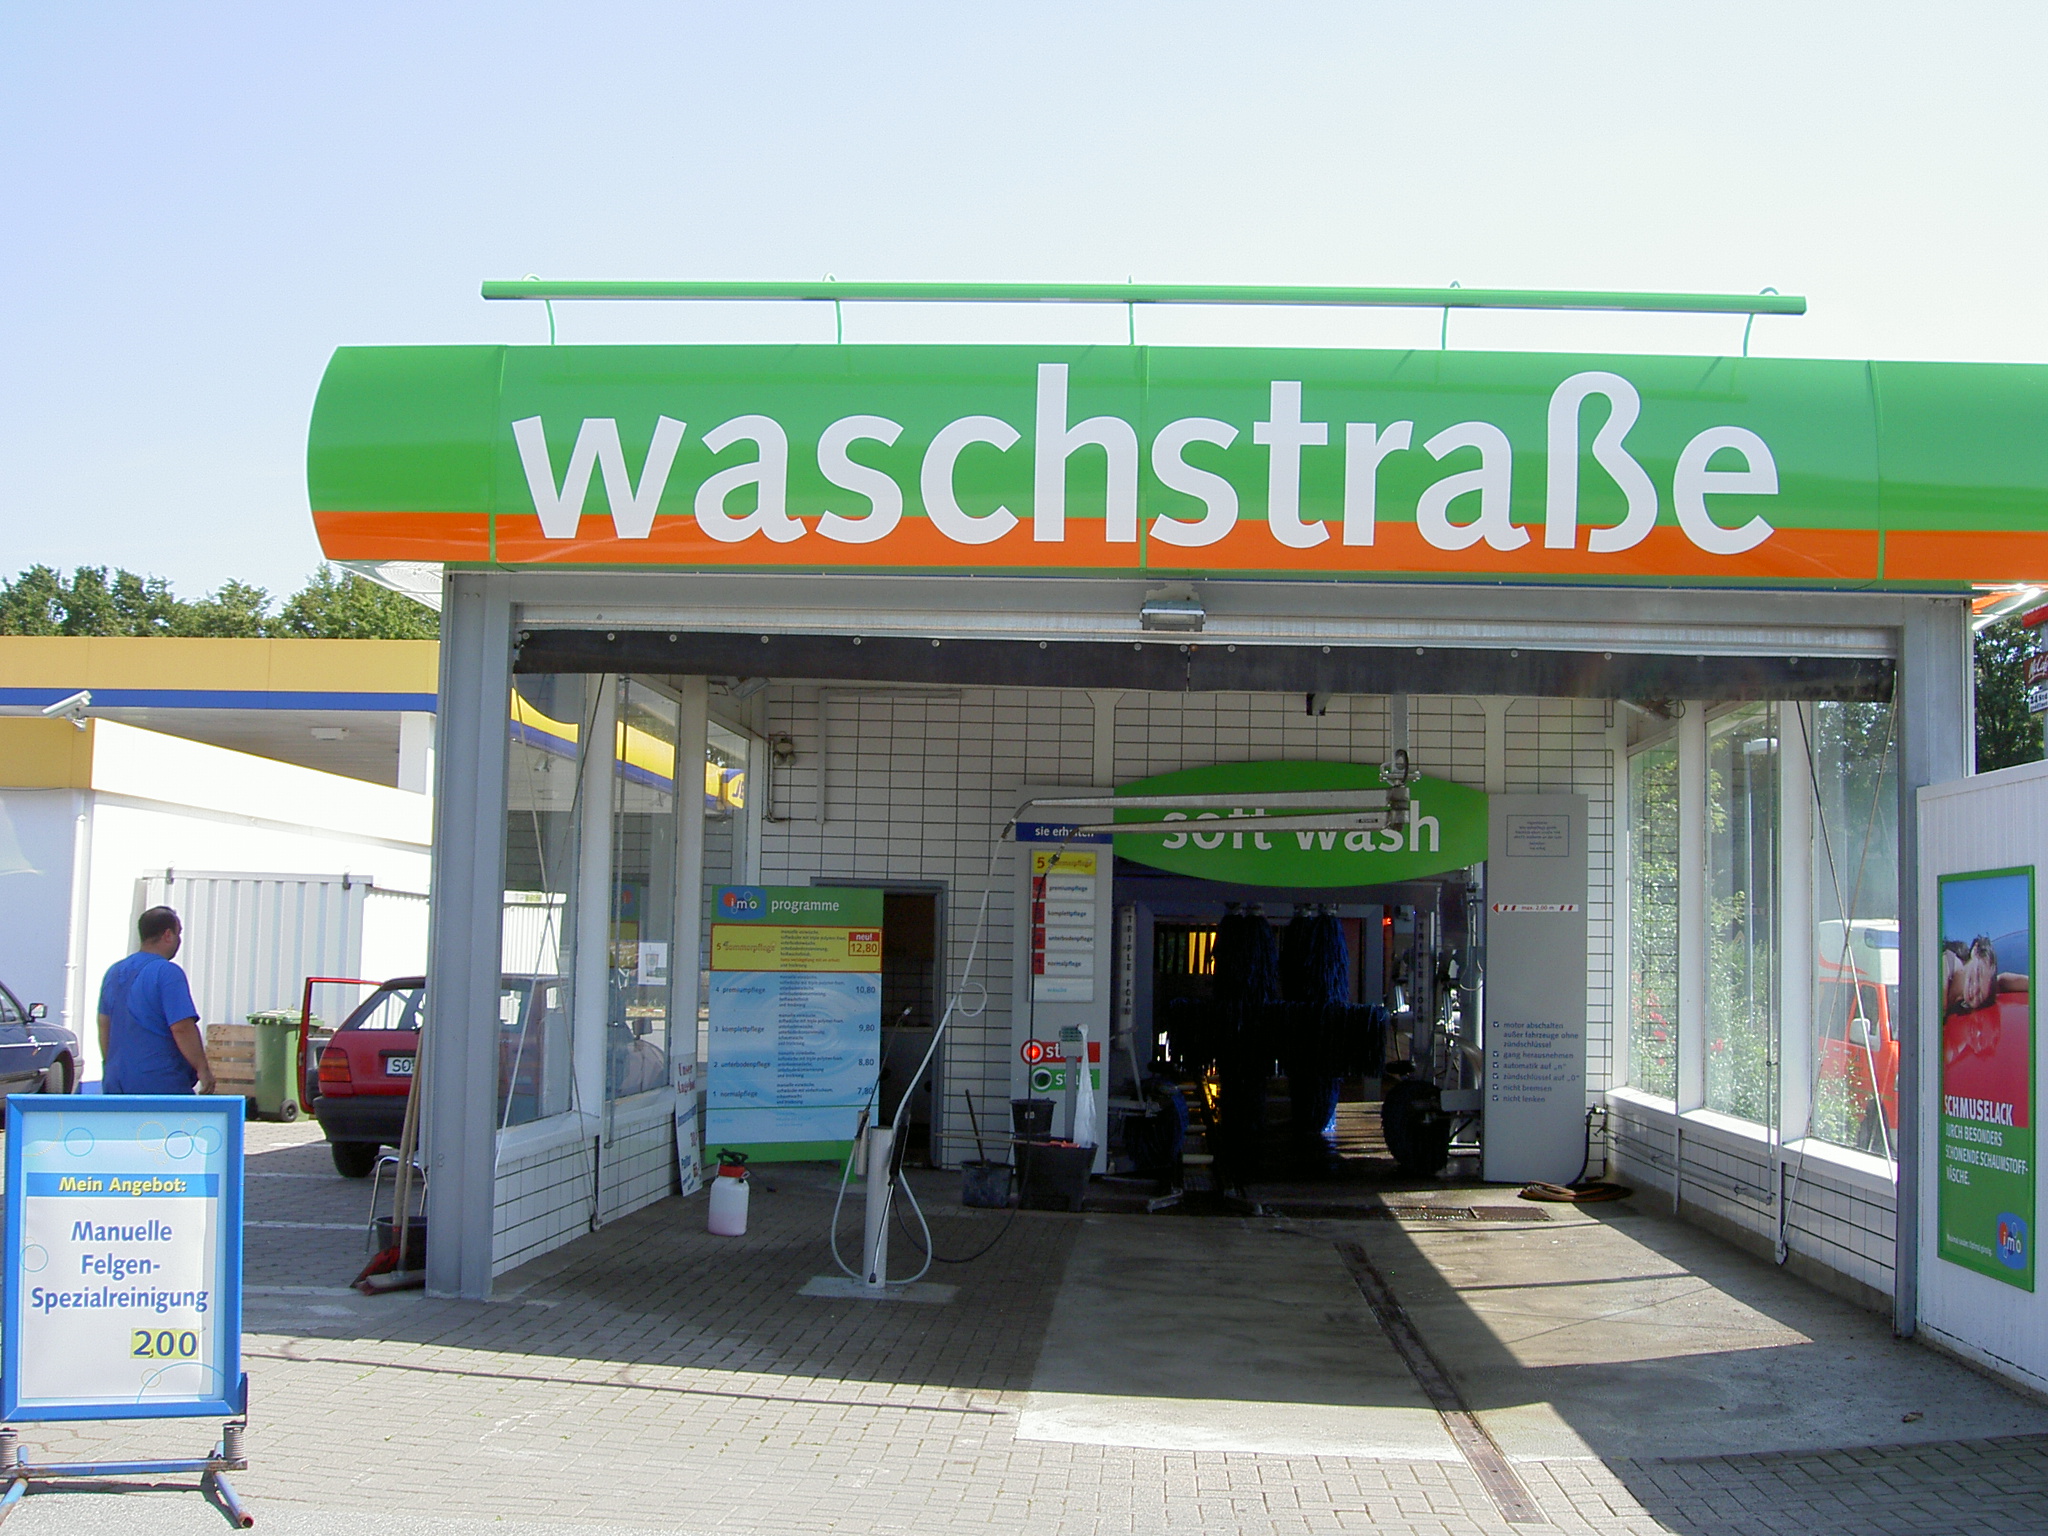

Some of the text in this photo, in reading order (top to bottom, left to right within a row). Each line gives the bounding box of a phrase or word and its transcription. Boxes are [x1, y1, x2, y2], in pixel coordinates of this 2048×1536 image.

[511, 363, 1779, 554] waschstraße
[1034, 826, 1050, 836] sie
[1036, 857, 1045, 868] 5
[730, 898, 840, 913] imo programme
[855, 933, 873, 941] neu!
[850, 943, 878, 954] 12,80
[856, 985, 876, 994] 10,80
[858, 1024, 875, 1033] 9,80
[1561, 1031, 1579, 1039] ohne
[1522, 1051, 1574, 1059] herausnehmen
[1540, 1062, 1552, 1070] auf
[857, 1087, 874, 1096] 7,80
[1522, 1084, 1553, 1092] bremsen
[1522, 1095, 1546, 1103] lenken
[1944, 1094, 2014, 1127] SCHMUSELACK
[1964, 1125, 2003, 1147] BESONDERS
[1945, 1144, 2029, 1175] SCHONENDE SCHAUMSTOFF-
[58, 1176, 187, 1196] Mein Angebot:
[71, 1220, 173, 1242] Manuelle
[2003, 1231, 2022, 1254] imo
[81, 1253, 161, 1280] Felgen-
[31, 1286, 209, 1314] Spezialreinigung
